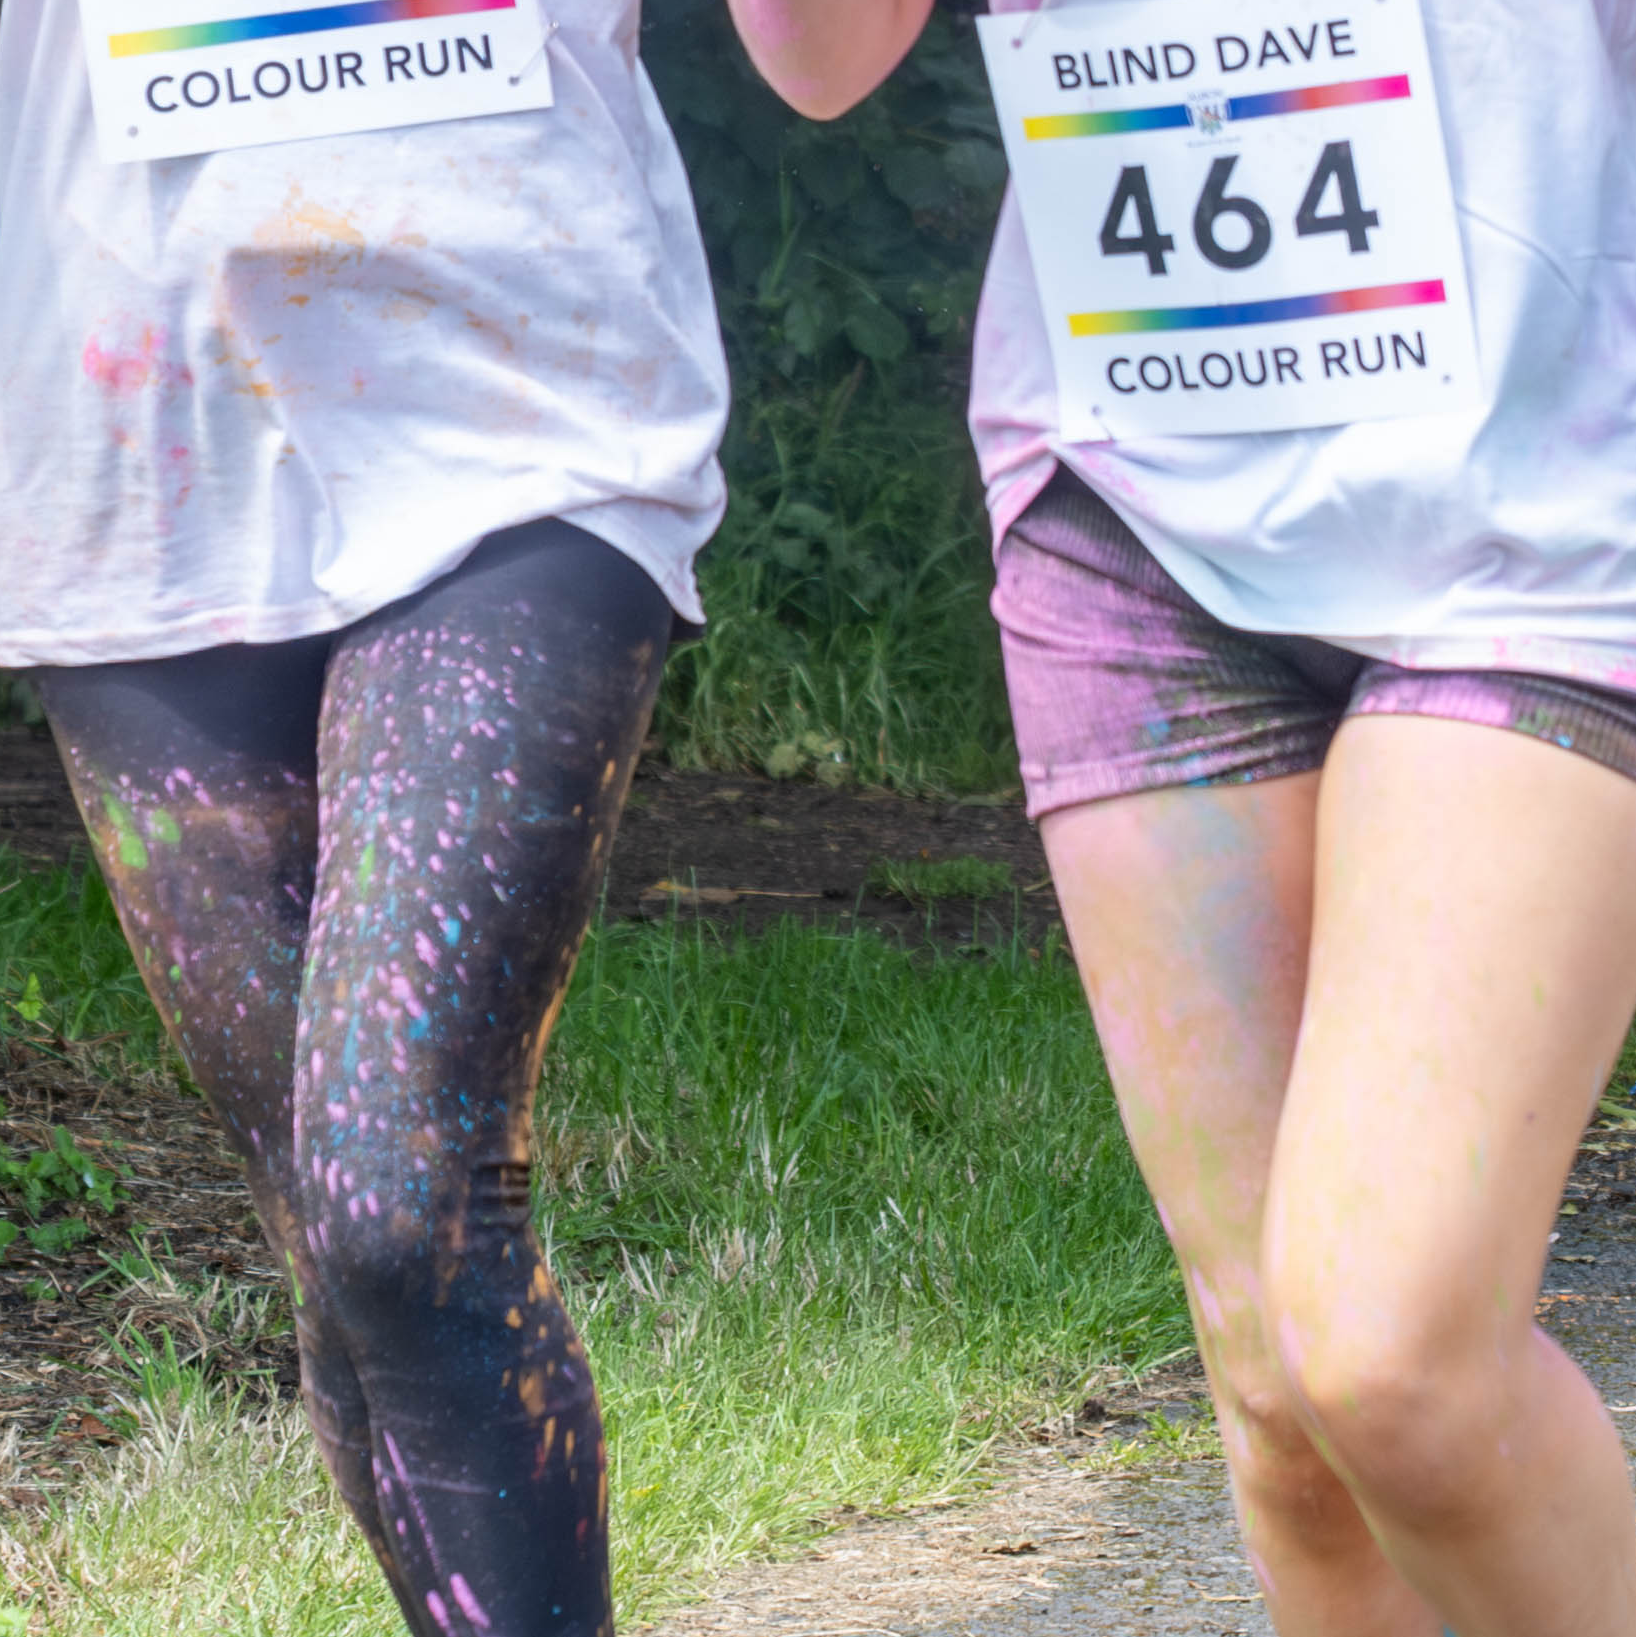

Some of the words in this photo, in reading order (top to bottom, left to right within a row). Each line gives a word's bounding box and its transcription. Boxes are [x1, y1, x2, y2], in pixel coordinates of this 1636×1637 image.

[145, 52, 366, 113] COLOUR
[383, 34, 494, 82] RUN
[1052, 42, 1196, 90] BLIND
[1216, 19, 1357, 73] DAVE
[1099, 139, 1379, 277] 464
[1107, 345, 1301, 393] COLOUR
[1320, 331, 1427, 378] RUN
